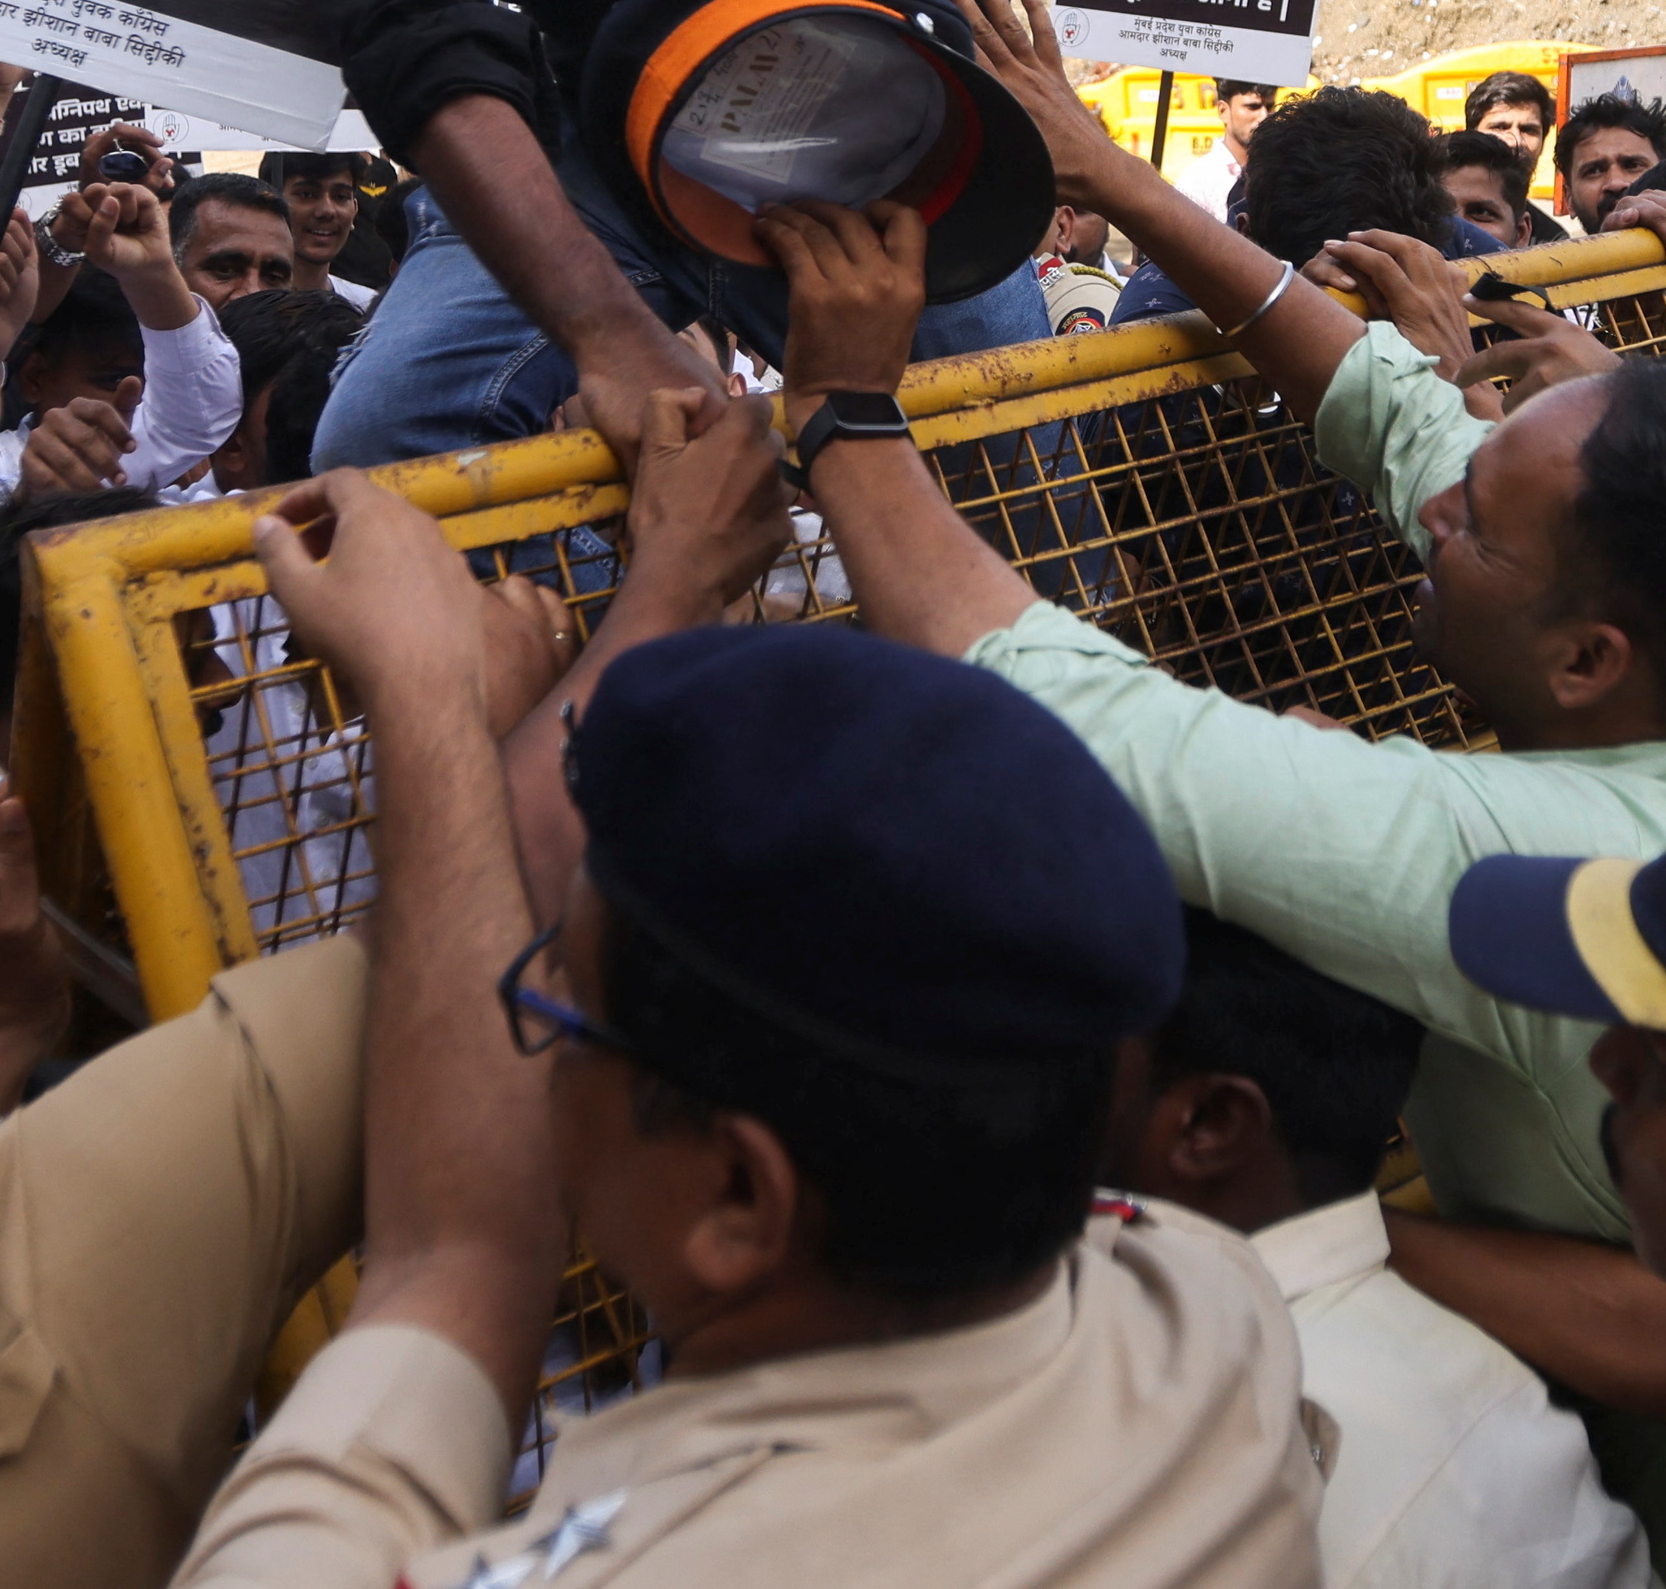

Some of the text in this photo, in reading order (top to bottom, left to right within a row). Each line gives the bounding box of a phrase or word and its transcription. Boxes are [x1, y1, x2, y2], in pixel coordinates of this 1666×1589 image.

[23, 6, 80, 37] झीशान
[83, 24, 122, 49] बाबा
[1134, 17, 1153, 31] मुंबई
[1155, 18, 1175, 34] प्रदेश
[1177, 24, 1194, 37] युवा
[1118, 29, 1150, 43] आमदार
[1183, 38, 1201, 49] बाबा
[32, 37, 89, 68] अध्यक्ष
[1160, 48, 1188, 61] अध्यक्ष
[58, 127, 87, 145] का
